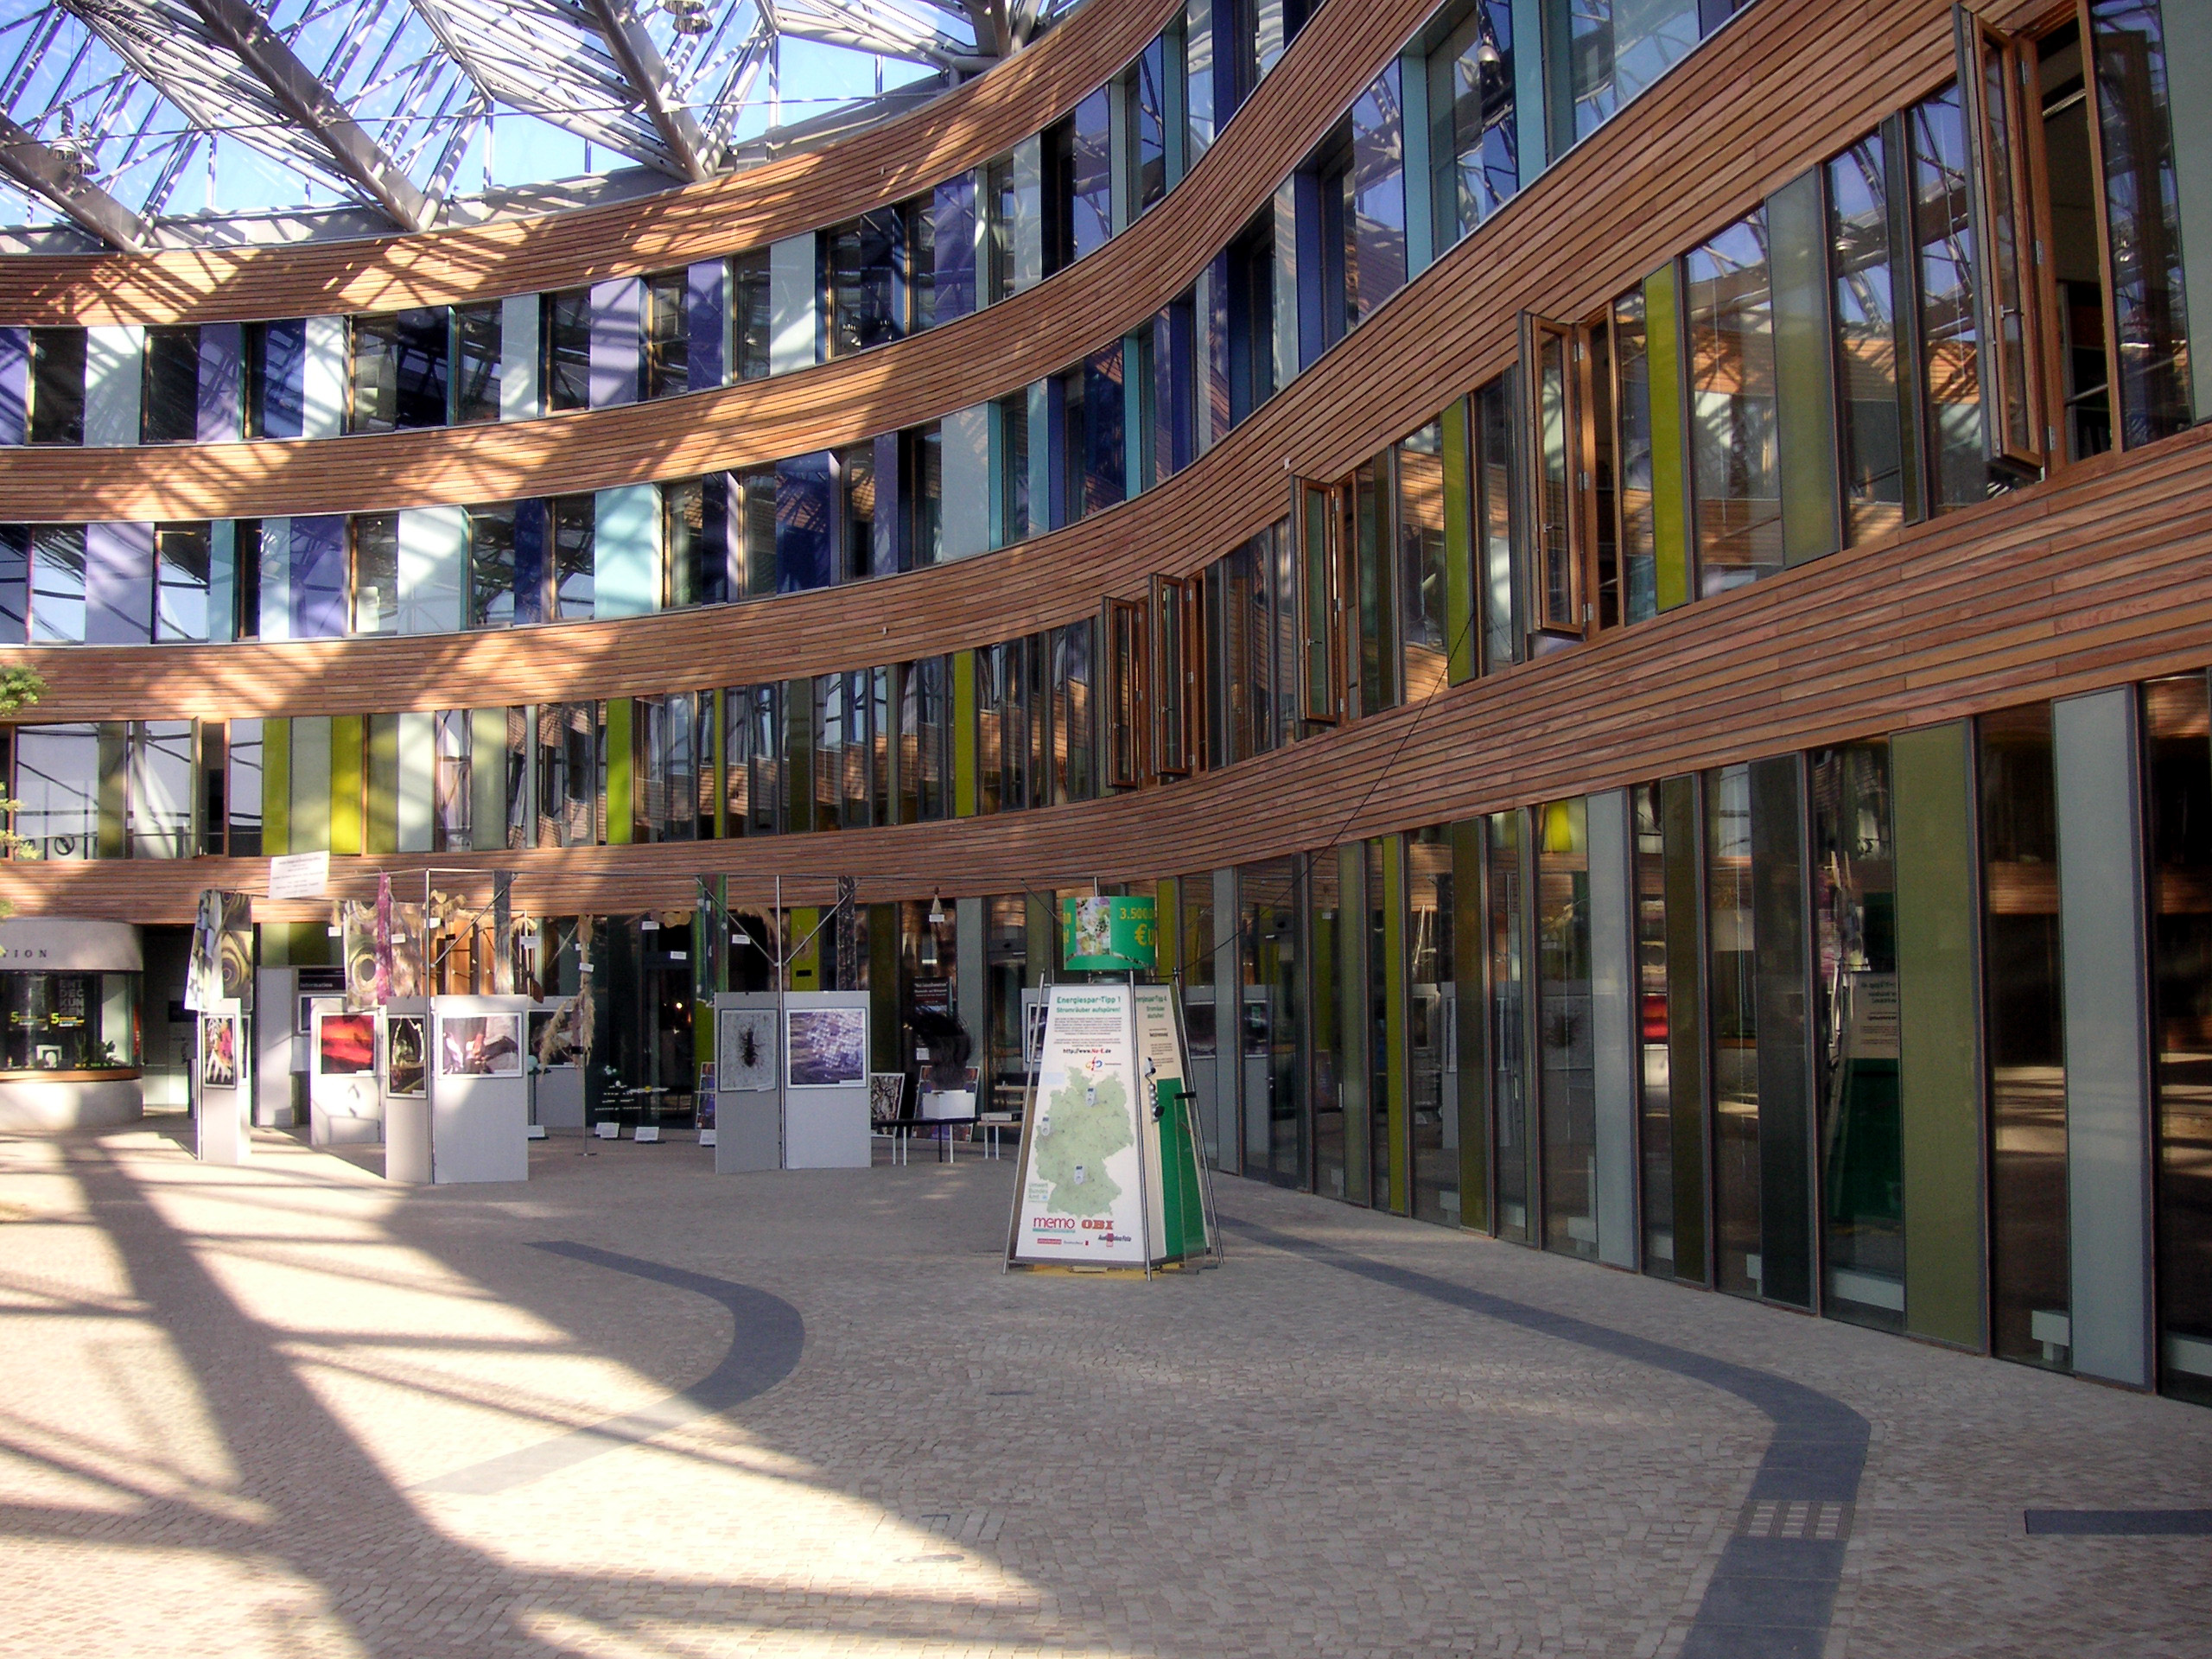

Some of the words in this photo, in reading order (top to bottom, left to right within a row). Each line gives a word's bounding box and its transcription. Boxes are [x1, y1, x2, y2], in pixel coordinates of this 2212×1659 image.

[1057, 996, 1116, 1005] Energiespar-Tipp
[1033, 1217, 1075, 1230] memo
[1081, 1219, 1115, 1230] OBI
